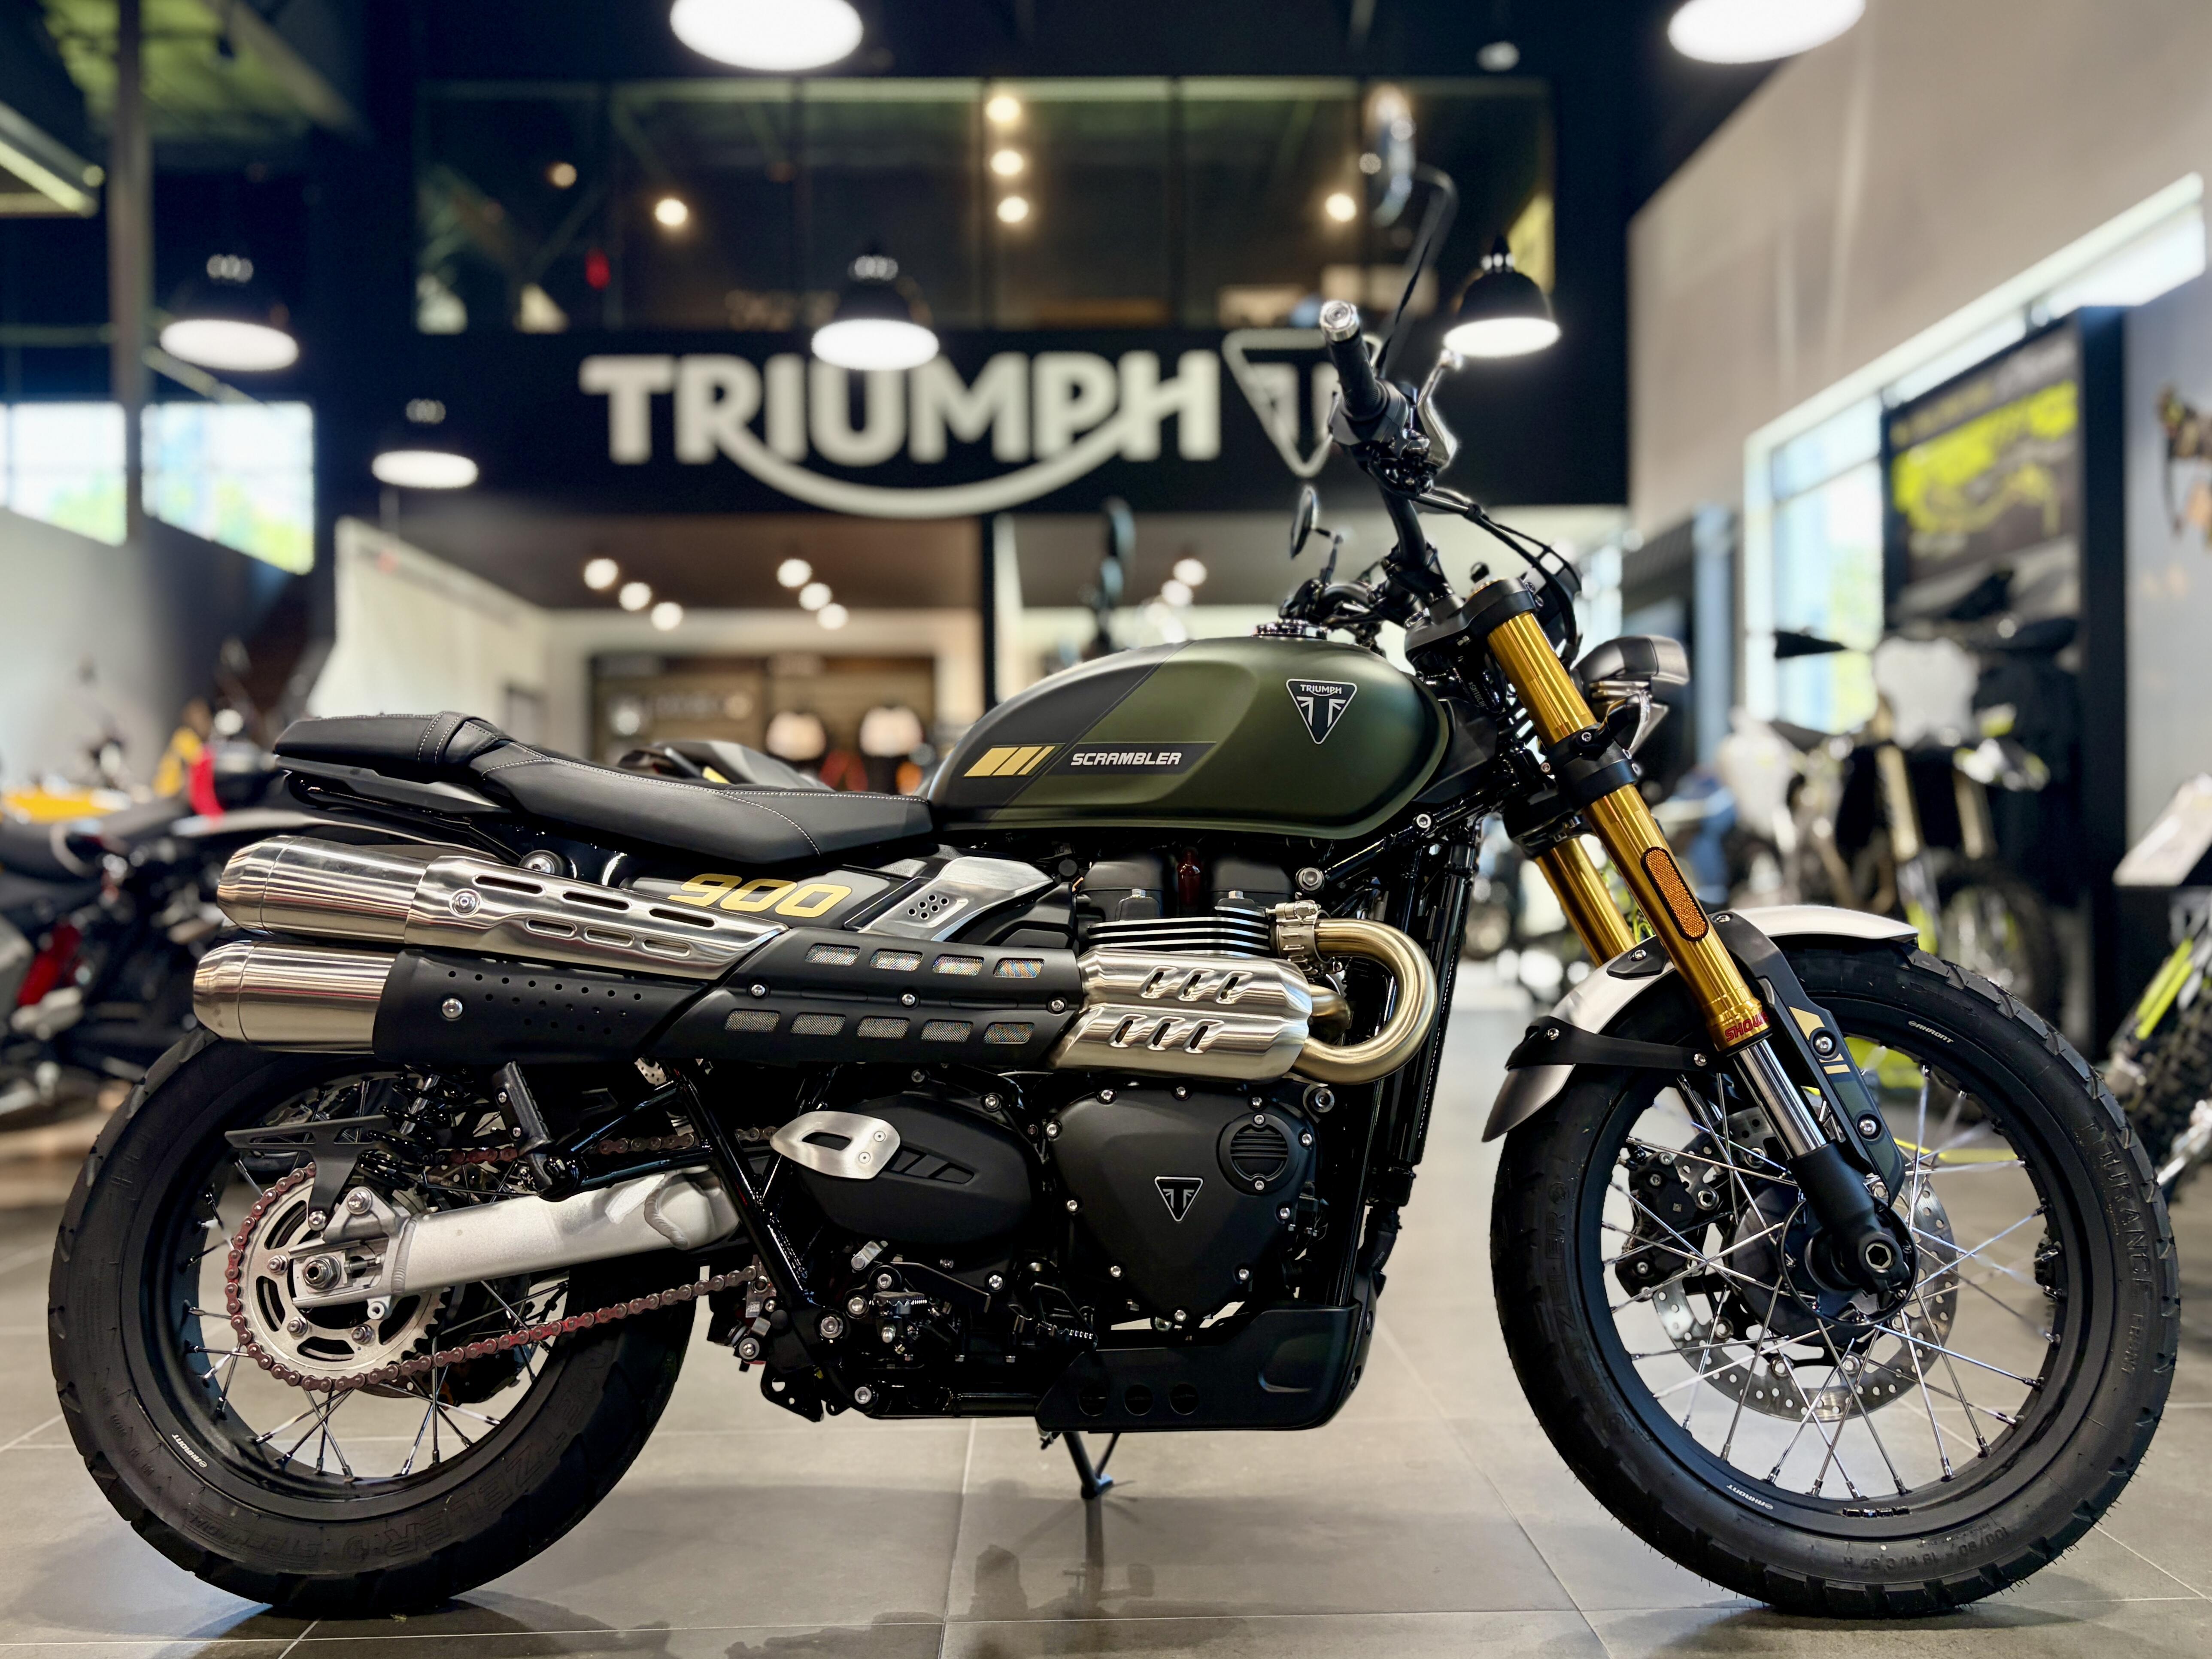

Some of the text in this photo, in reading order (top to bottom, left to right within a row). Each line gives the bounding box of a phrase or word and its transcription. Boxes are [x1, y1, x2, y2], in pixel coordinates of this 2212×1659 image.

[580, 351, 1222, 517] TRIUMPH
[1300, 684, 1342, 696] TRIUMPH
[1071, 752, 1182, 765] SCRAMBLER
[668, 873, 852, 918] 900
